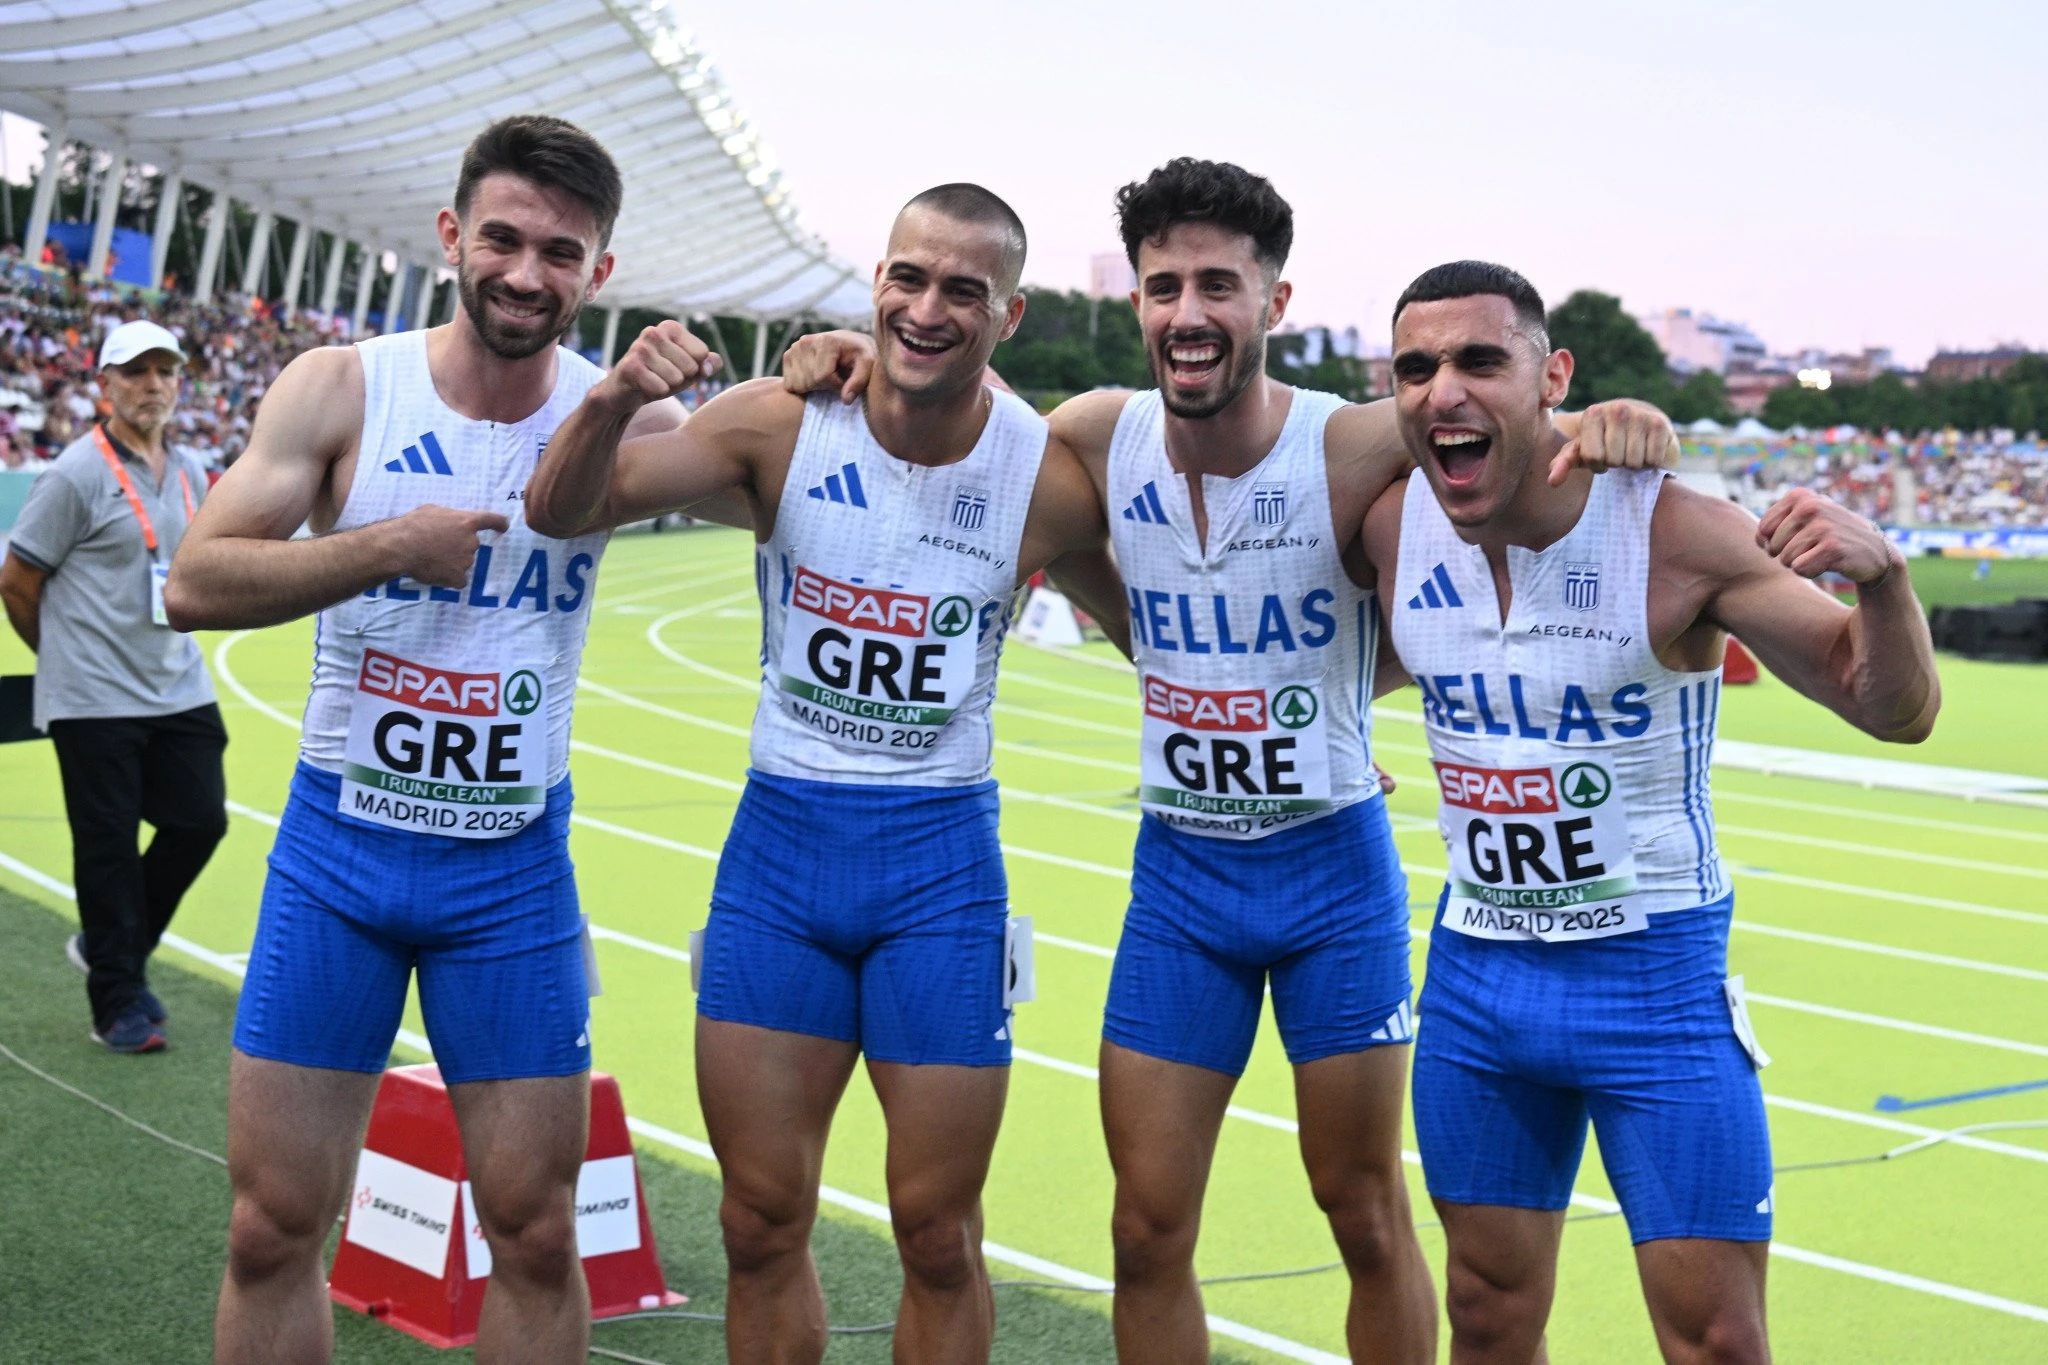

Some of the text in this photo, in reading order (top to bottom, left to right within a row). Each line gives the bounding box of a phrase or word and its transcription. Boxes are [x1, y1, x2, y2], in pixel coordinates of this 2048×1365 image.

[918, 534, 991, 563] AEGEAN
[1227, 535, 1303, 553] AEGEAN
[364, 544, 594, 612] LAS
[795, 573, 926, 634] SPAR
[1129, 588, 1337, 654] HELLAS
[1528, 624, 1613, 642] AEGEAN
[362, 655, 498, 711] SPAR
[807, 627, 947, 703] GRE
[792, 701, 938, 748] MADRID 202
[820, 692, 857, 713] RUN
[1147, 681, 1265, 727] SPAR
[1416, 673, 1652, 743] HELLAS
[373, 710, 522, 782] GRE
[1163, 732, 1303, 795] GRE
[389, 778, 428, 796] RUN
[1184, 795, 1218, 812] RUN
[1439, 768, 1553, 807] SPAR
[354, 790, 528, 831] MADRID 2025
[1467, 816, 1606, 885] GRE
[1560, 904, 1626, 931] 2025
